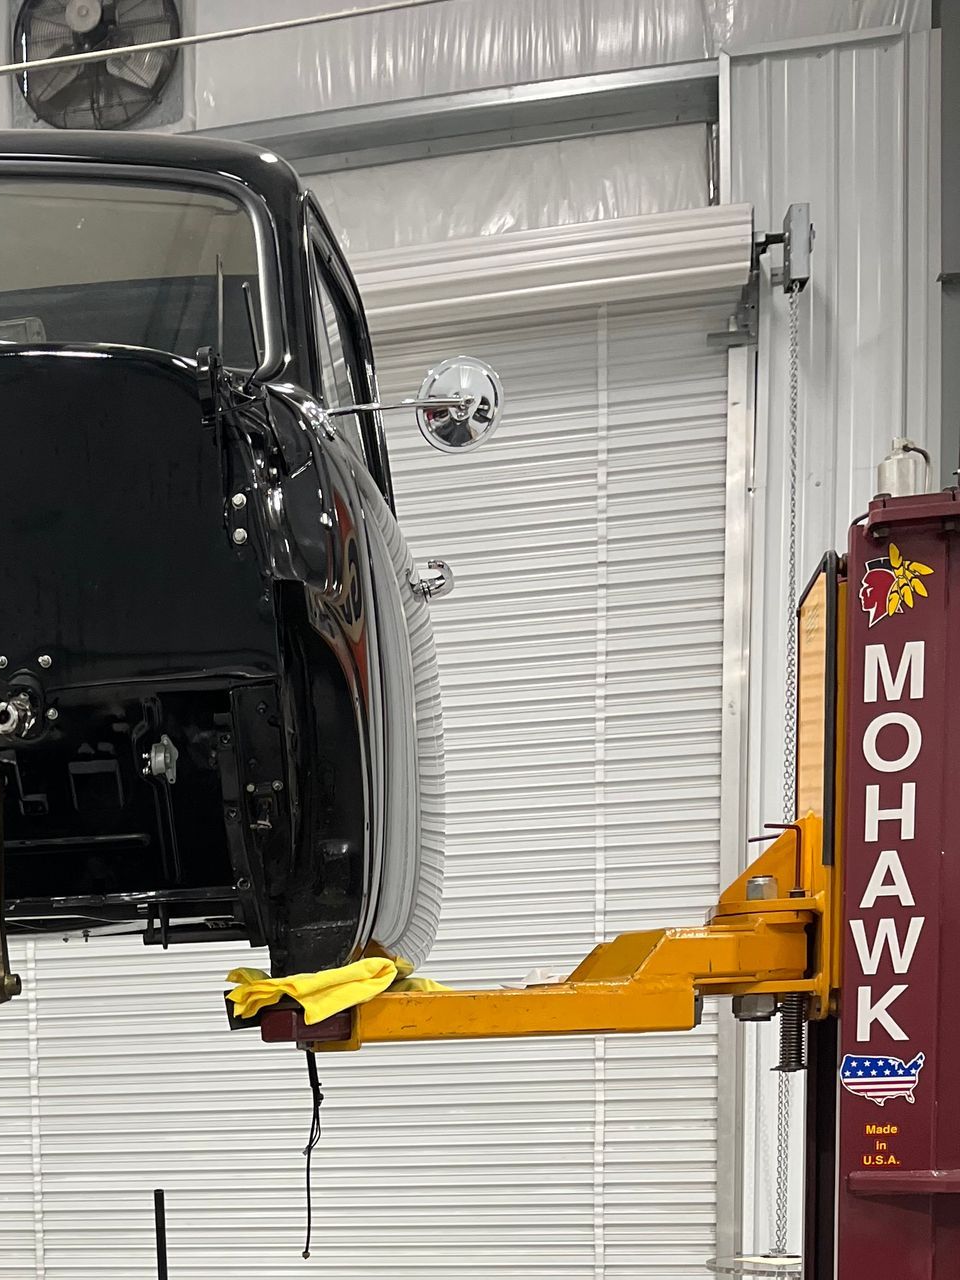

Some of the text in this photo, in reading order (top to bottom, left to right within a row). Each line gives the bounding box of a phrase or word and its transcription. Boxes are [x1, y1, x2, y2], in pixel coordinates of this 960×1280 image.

[849, 640, 925, 1042] MOHAWK
[865, 1124, 898, 1135] Made
[875, 1140, 887, 1150] in
[863, 1155, 900, 1165] U.S.A.
